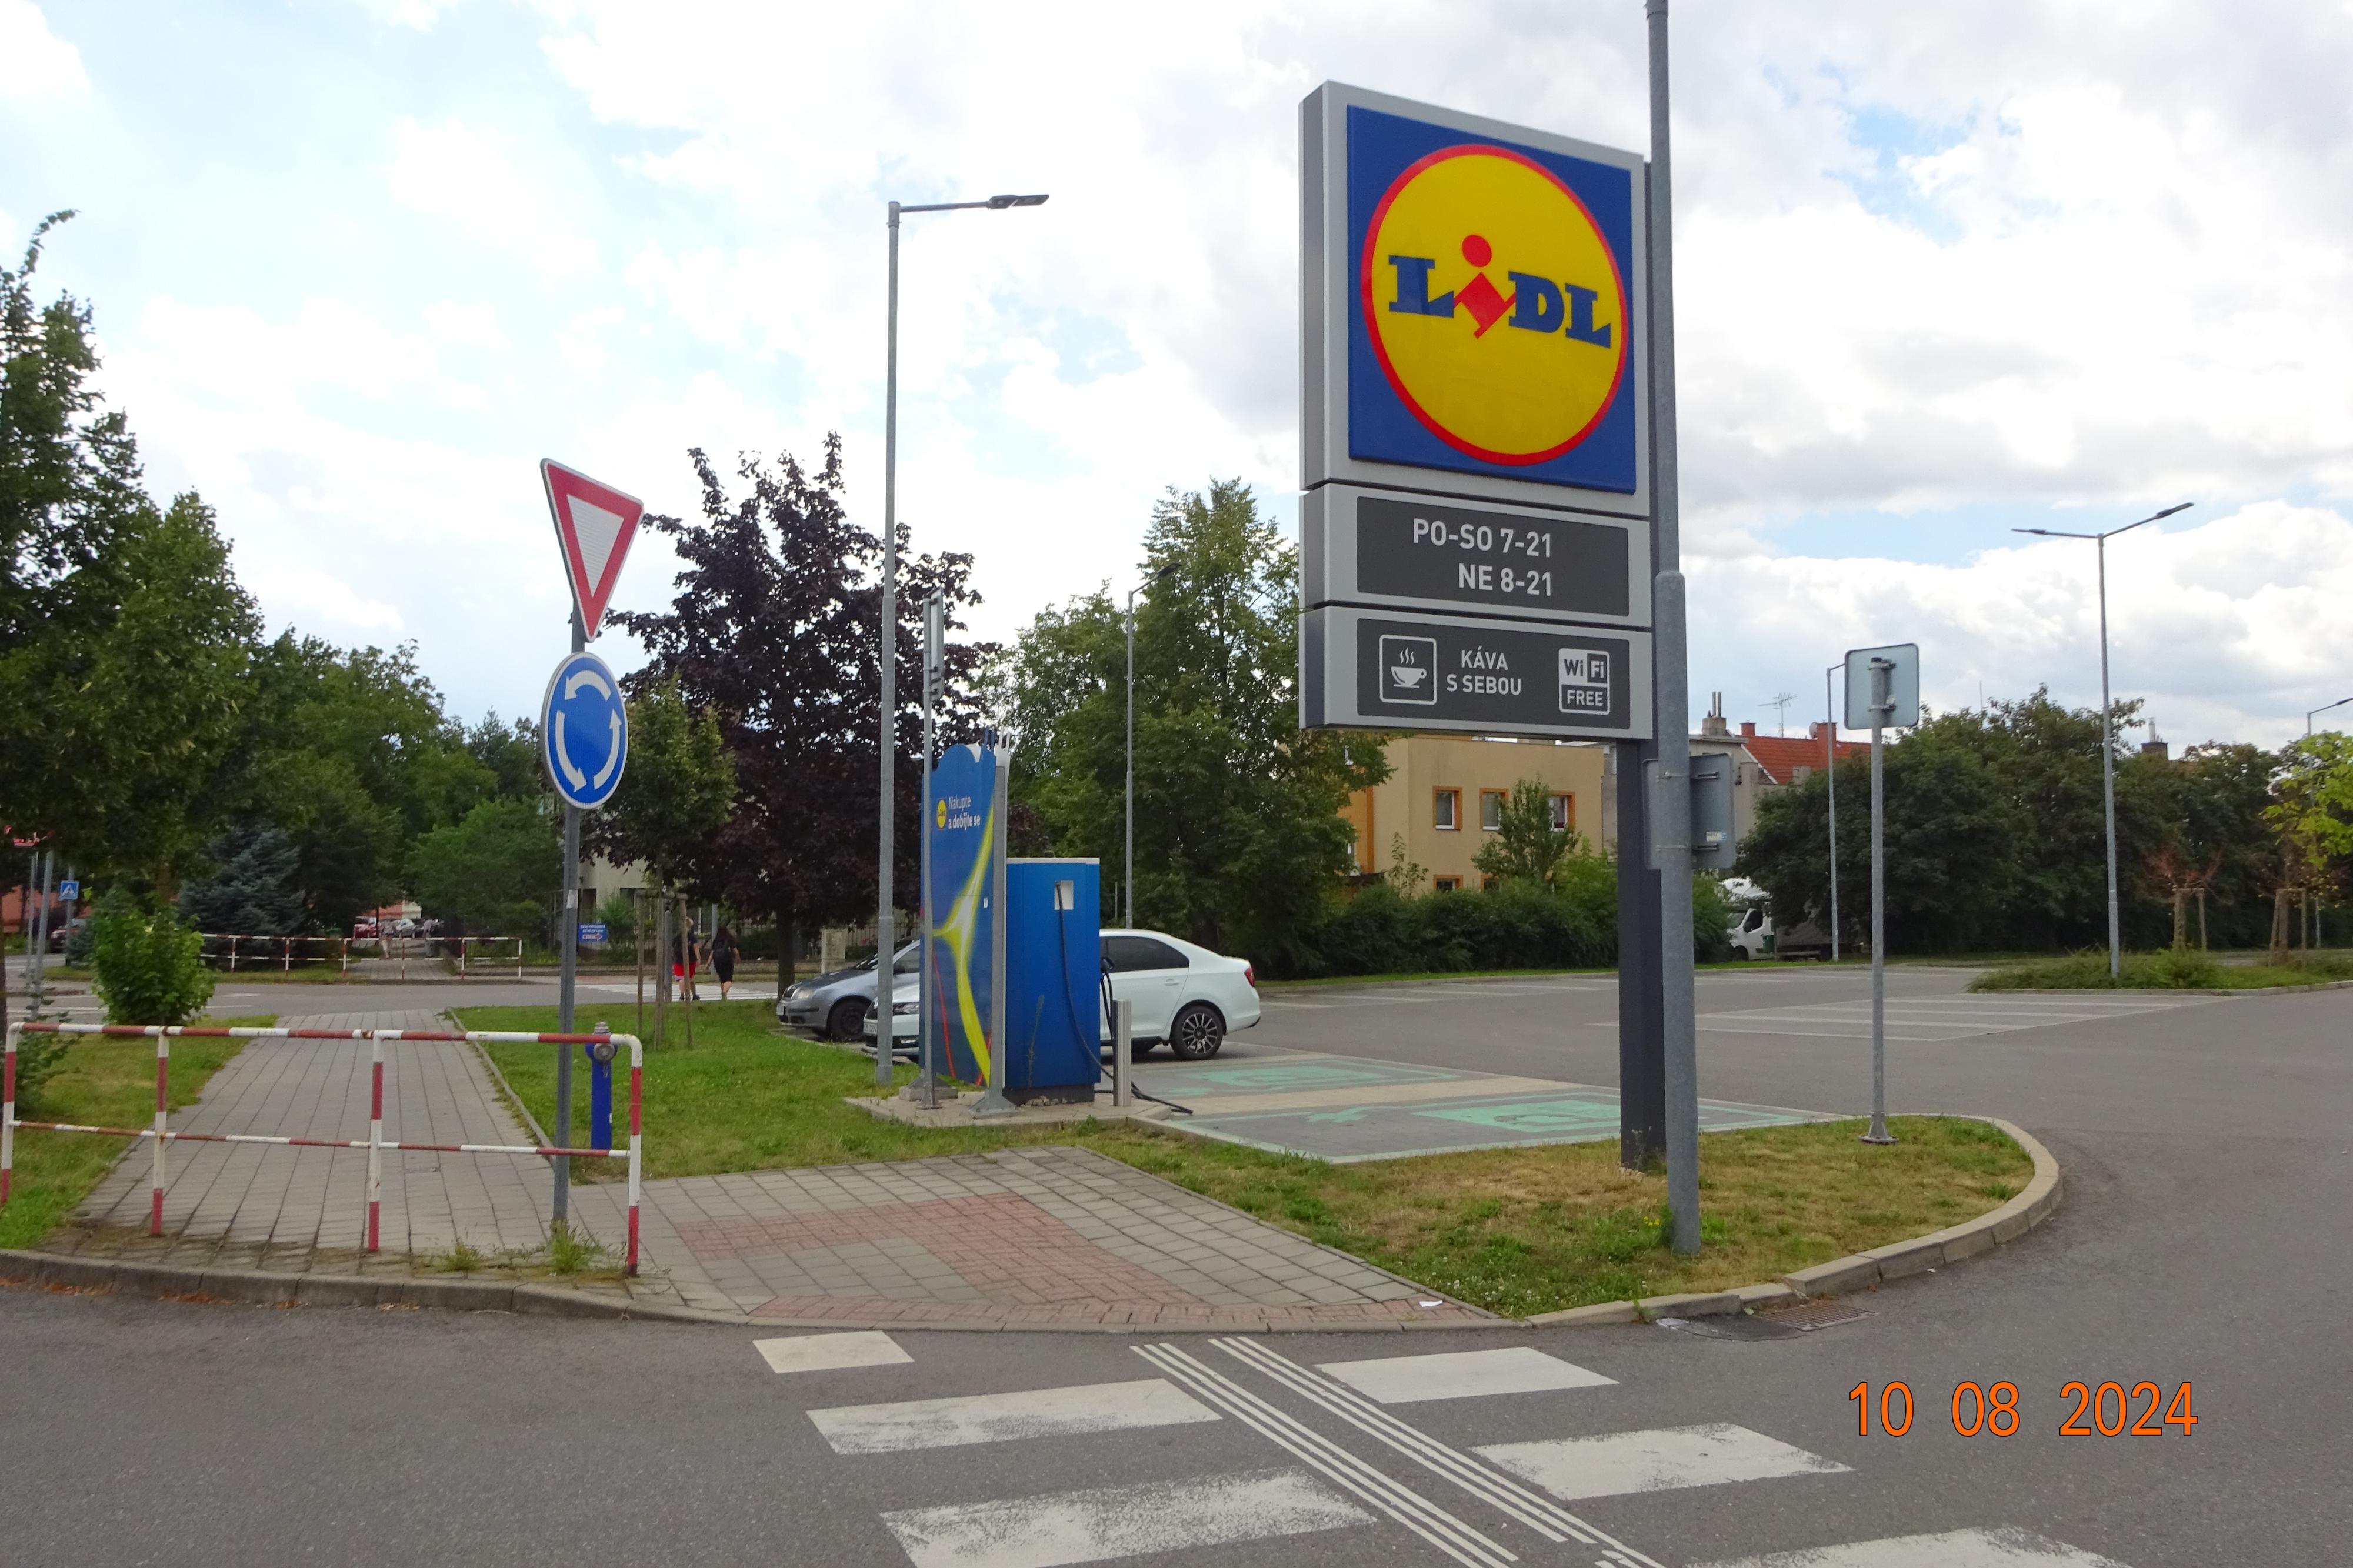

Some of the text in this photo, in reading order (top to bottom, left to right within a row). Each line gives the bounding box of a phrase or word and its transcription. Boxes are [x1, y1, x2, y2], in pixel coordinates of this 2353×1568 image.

[1413, 518, 1551, 558] PO-SO 7-21
[1458, 563, 1551, 596] NE 8-21
[1461, 645, 1508, 670] KÁVA
[1447, 674, 1521, 696] S SEBOU
[1567, 689, 1604, 706] FREE
[948, 795, 971, 812] Nakupte
[948, 818, 952, 829] a
[953, 812, 973, 831] dobijte
[974, 814, 981, 827] se
